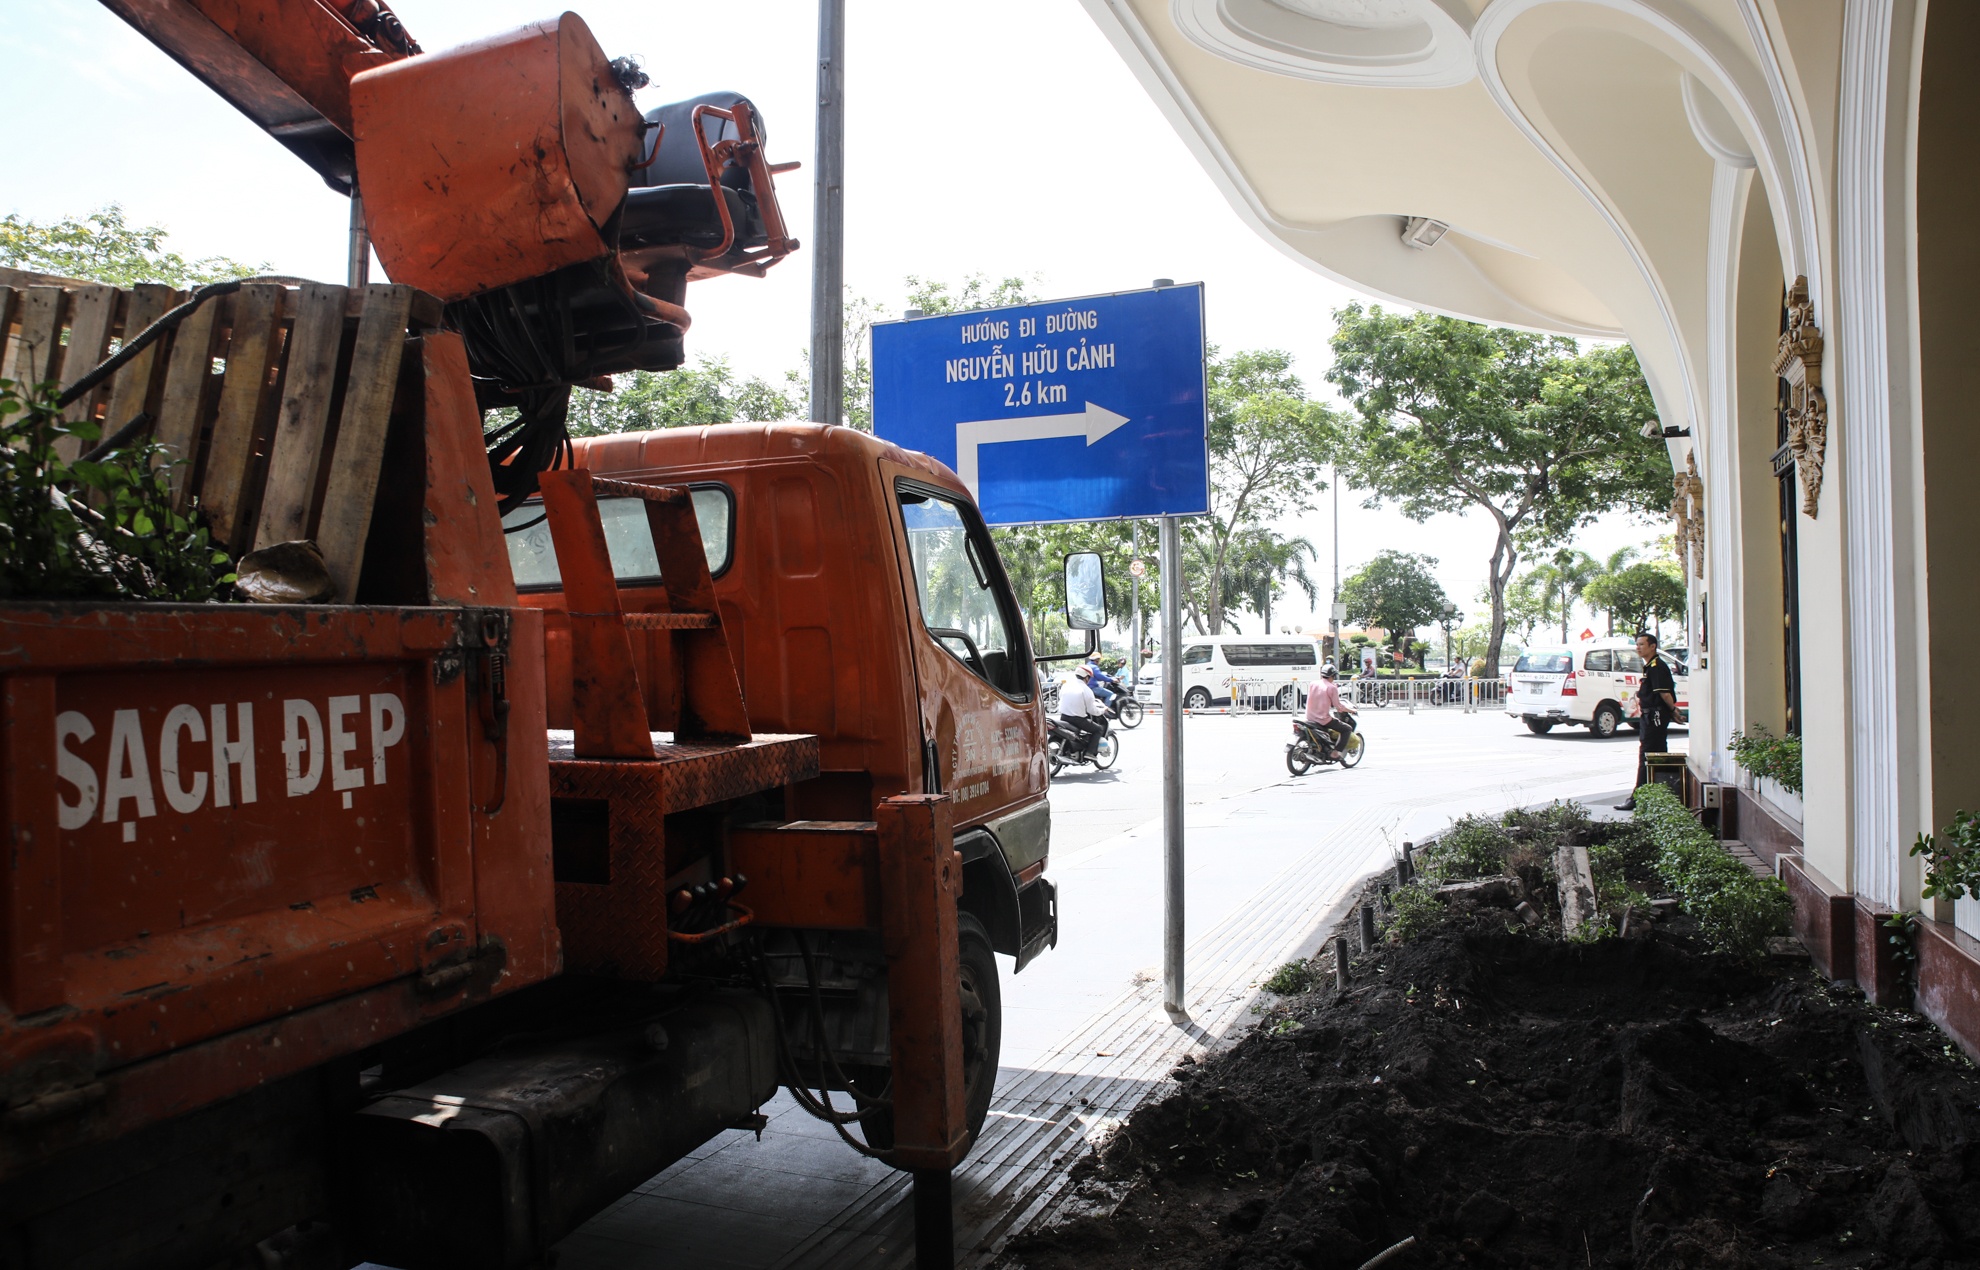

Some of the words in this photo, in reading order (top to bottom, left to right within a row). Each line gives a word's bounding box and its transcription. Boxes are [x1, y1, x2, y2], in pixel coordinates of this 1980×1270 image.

[961, 317, 1009, 345] HƯỚNG
[1019, 317, 1036, 338] ĐI
[1046, 308, 1098, 334] ĐƯỜNG
[946, 344, 1014, 383] NGUYỄN
[1022, 343, 1058, 376] HỮU
[1067, 337, 1115, 371] CẢNH
[1004, 382, 1032, 408] 2,6
[1037, 380, 1067, 404] km
[56, 702, 257, 842] SẠCH
[282, 692, 405, 809] ĐẸP
